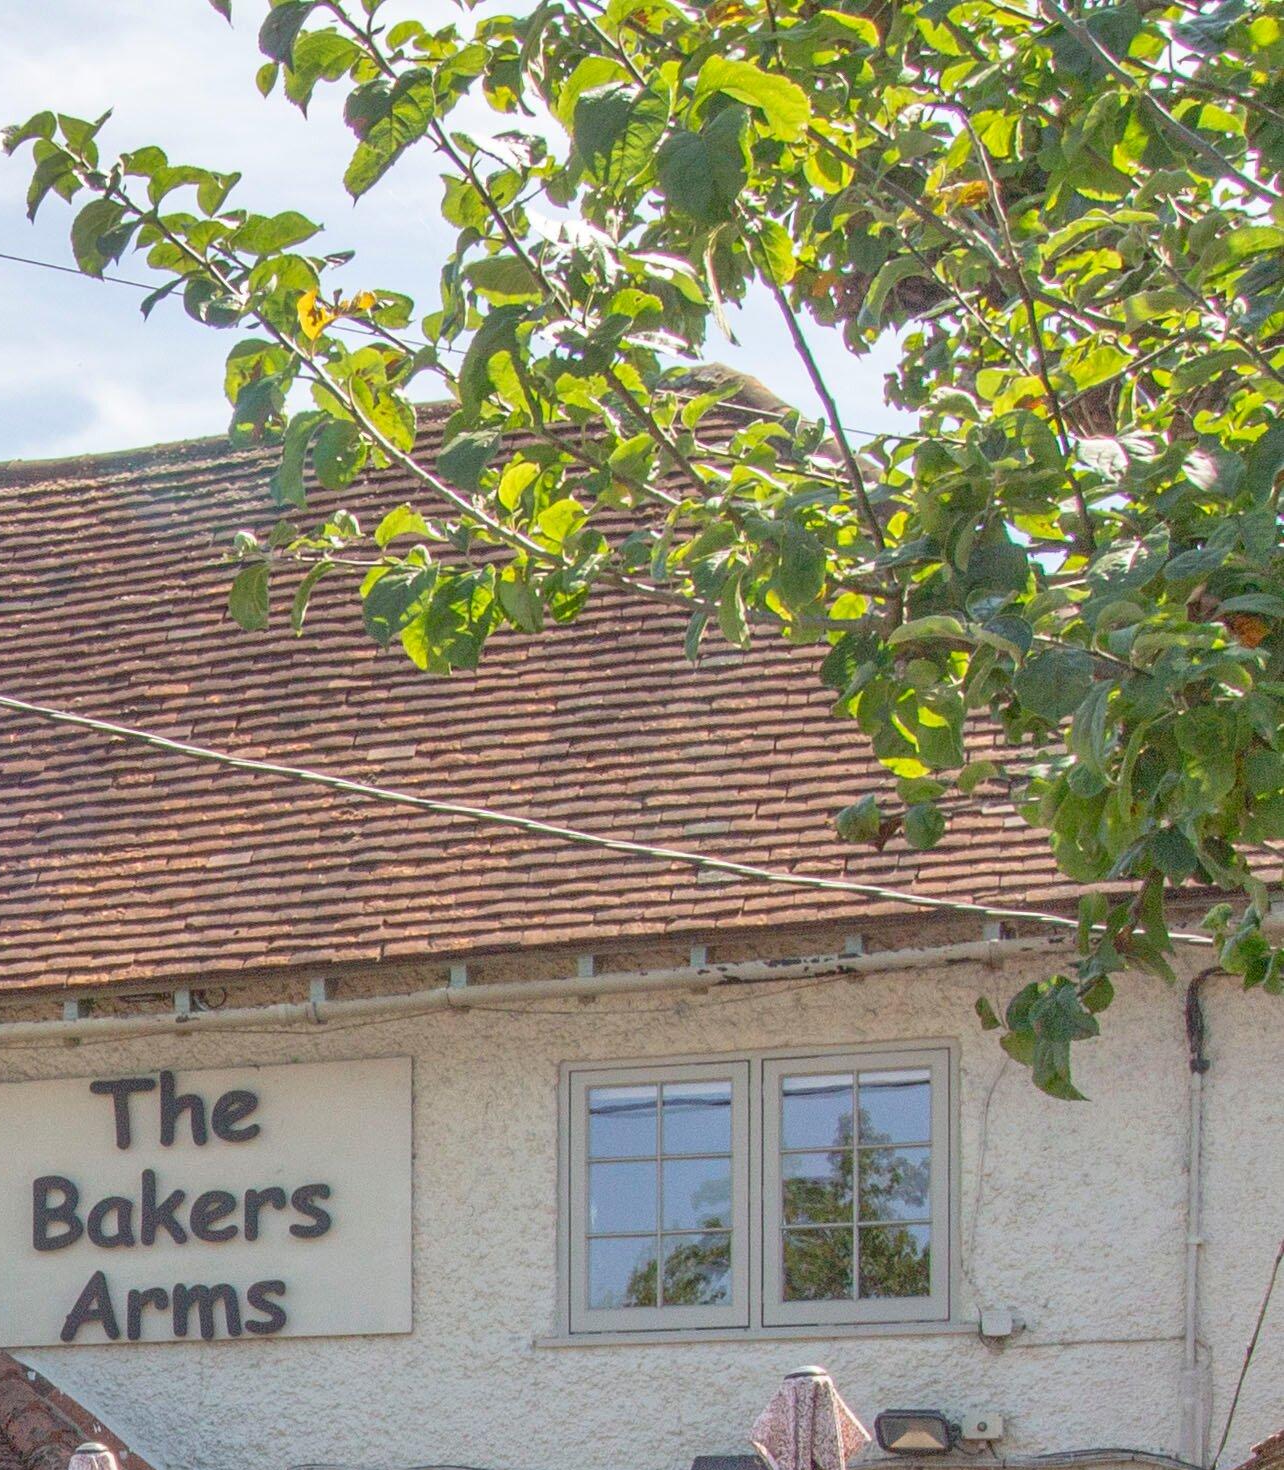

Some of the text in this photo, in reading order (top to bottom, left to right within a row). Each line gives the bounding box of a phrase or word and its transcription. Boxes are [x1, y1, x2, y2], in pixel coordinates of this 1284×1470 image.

[89, 1070, 261, 1150] The
[33, 1168, 332, 1251] Bakers
[60, 1270, 287, 1342] Arms
